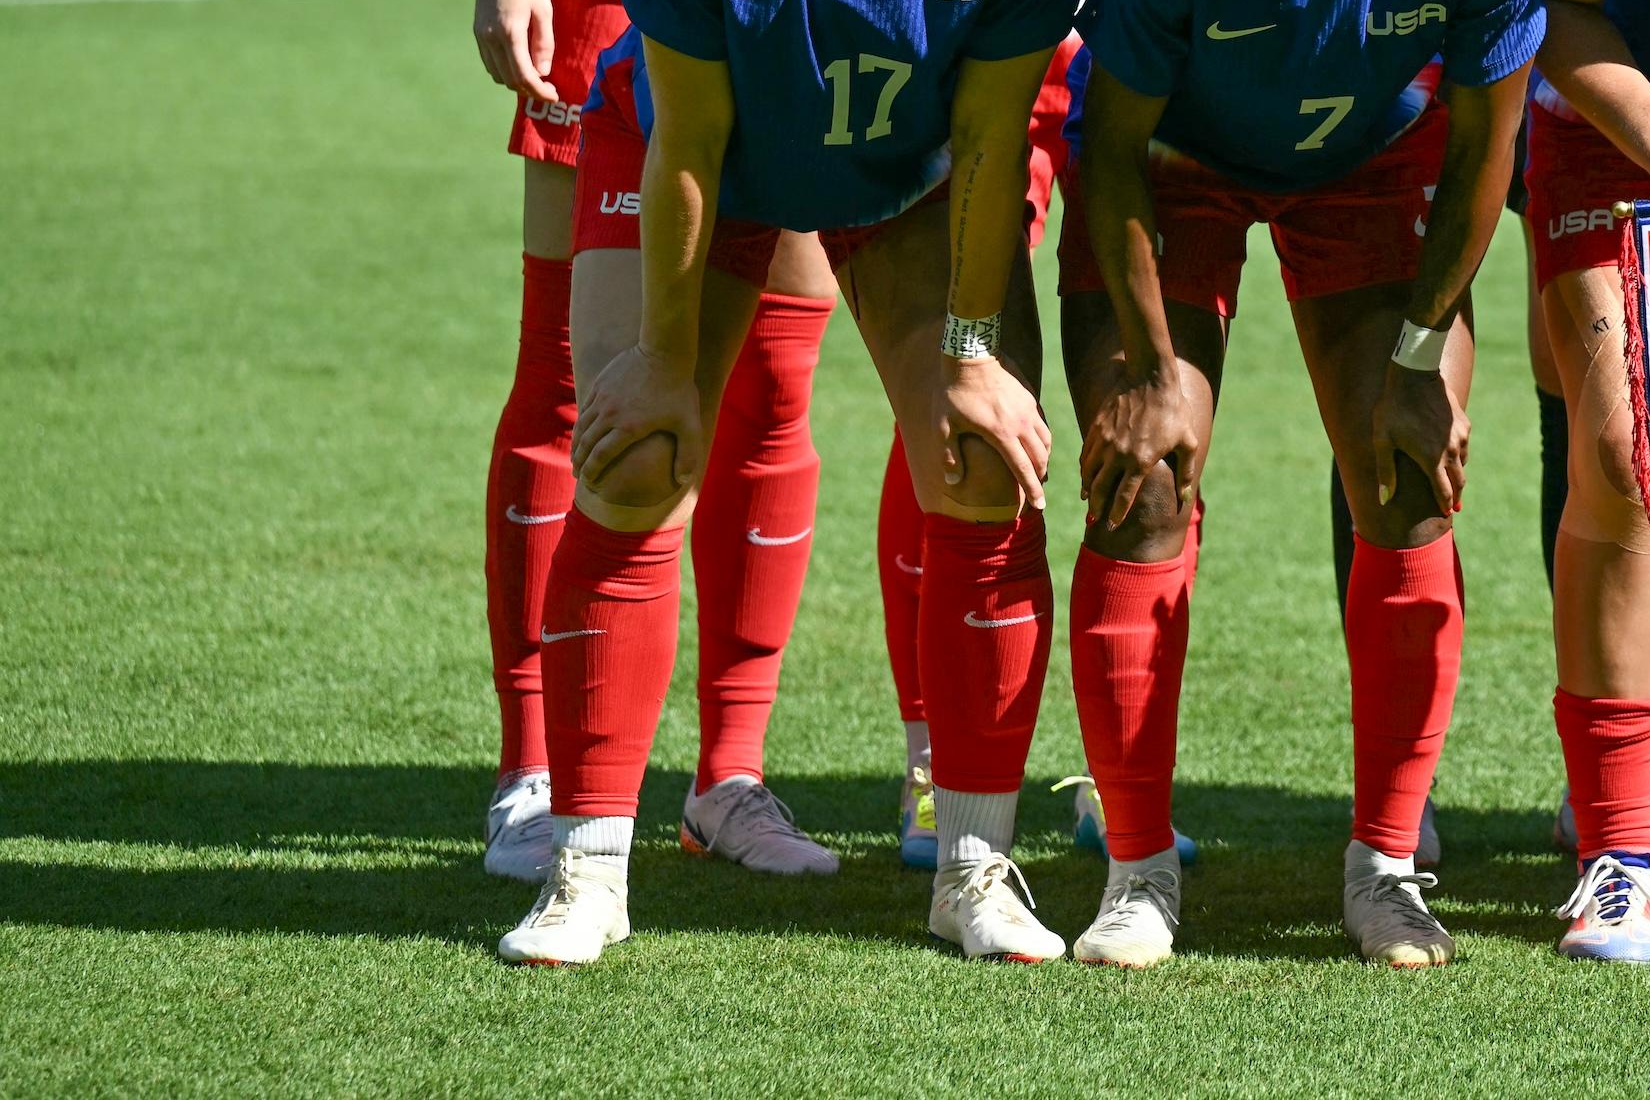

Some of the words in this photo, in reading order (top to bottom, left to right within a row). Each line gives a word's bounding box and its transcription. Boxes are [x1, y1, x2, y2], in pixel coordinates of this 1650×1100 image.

[1366, 2, 1447, 37] USA
[823, 52, 913, 146] 17
[1294, 95, 1356, 151] 7
[600, 192, 640, 214] US
[1549, 209, 1614, 240] USA
[1592, 316, 1609, 334] KT
